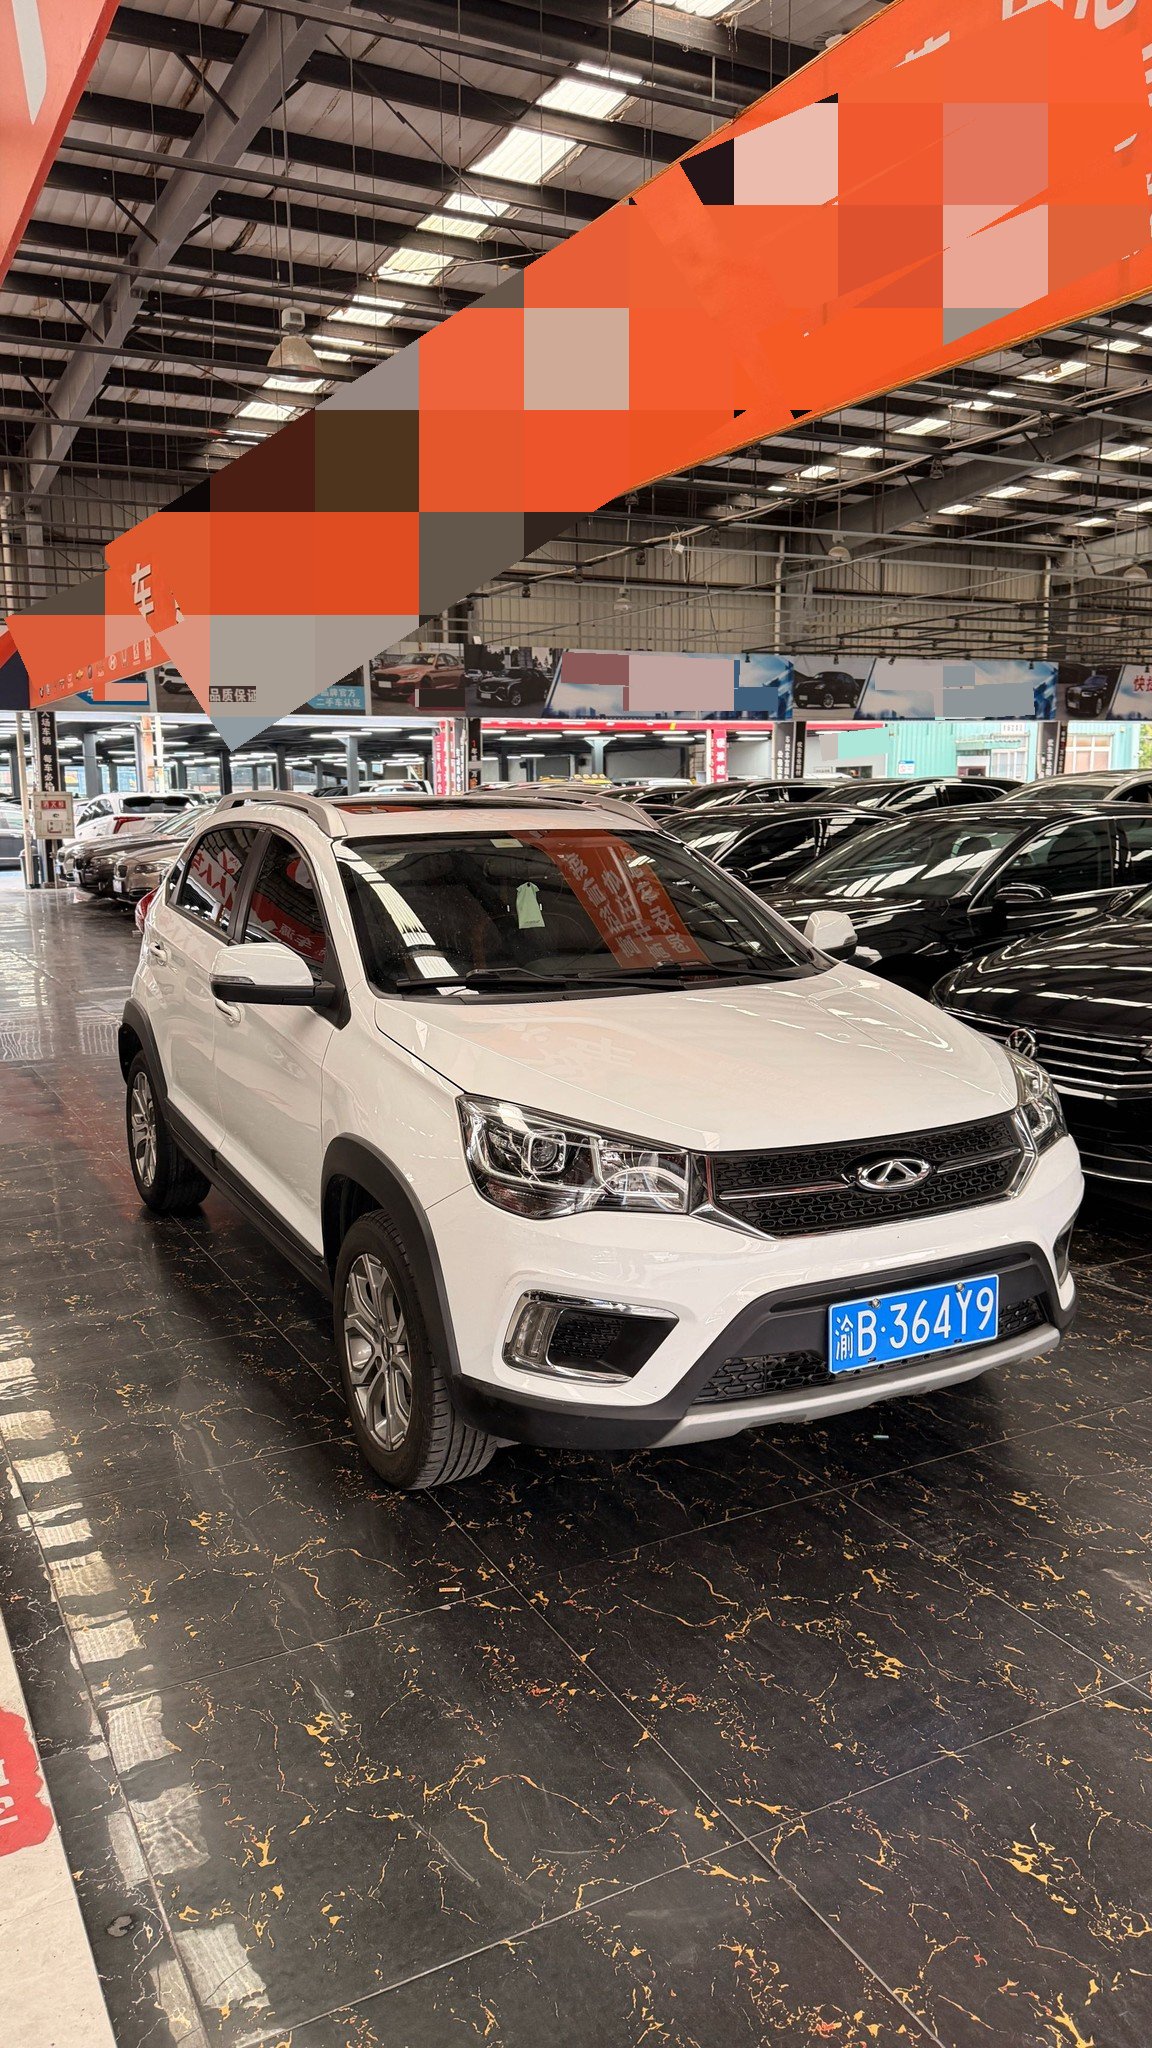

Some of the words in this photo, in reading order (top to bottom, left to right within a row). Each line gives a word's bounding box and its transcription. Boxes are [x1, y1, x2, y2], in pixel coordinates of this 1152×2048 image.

[209, 688, 256, 702] 品质保证
[316, 698, 361, 707] 二手车认证
